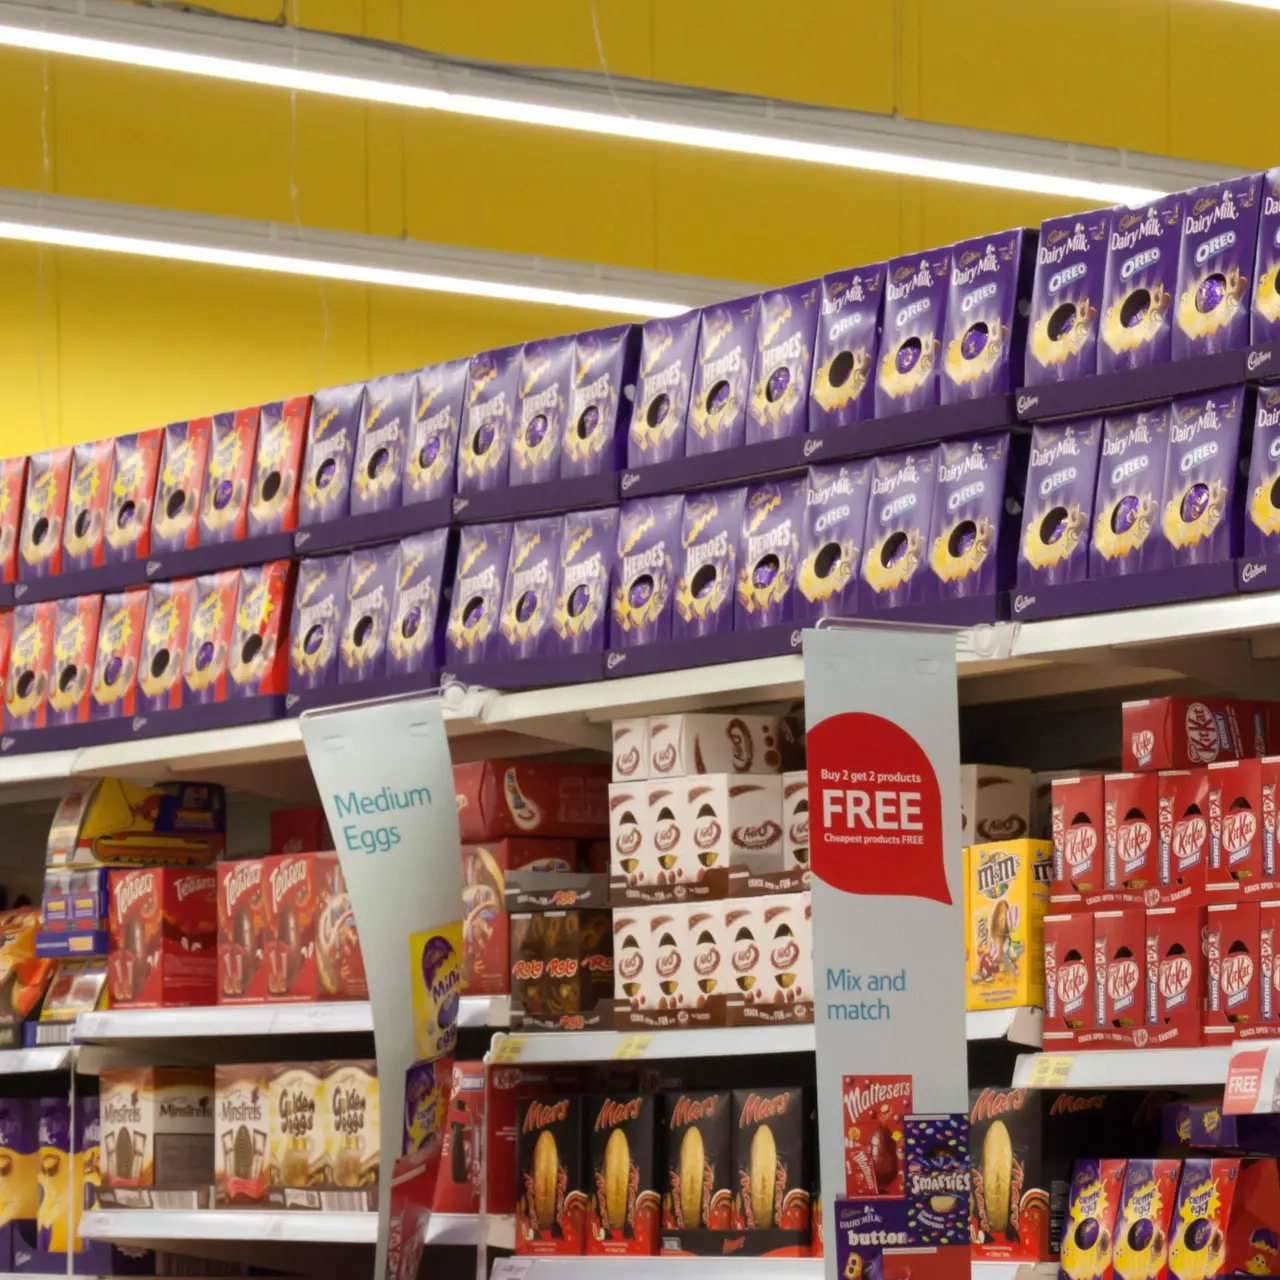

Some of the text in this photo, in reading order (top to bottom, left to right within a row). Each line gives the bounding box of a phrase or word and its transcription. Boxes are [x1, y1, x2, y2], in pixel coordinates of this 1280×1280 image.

[821, 769, 921, 785] Buy 2 get 2 products
[335, 787, 431, 818] Medium
[823, 791, 922, 830] FREE
[345, 826, 401, 854] Eggs
[824, 833, 923, 846] Cheapest products FREE
[827, 969, 905, 992] Mix and
[827, 998, 890, 1020] match
[1229, 1075, 1257, 1095] FREE
[739, 1091, 789, 1127] Mars
[844, 1082, 910, 1120] Maltesers
